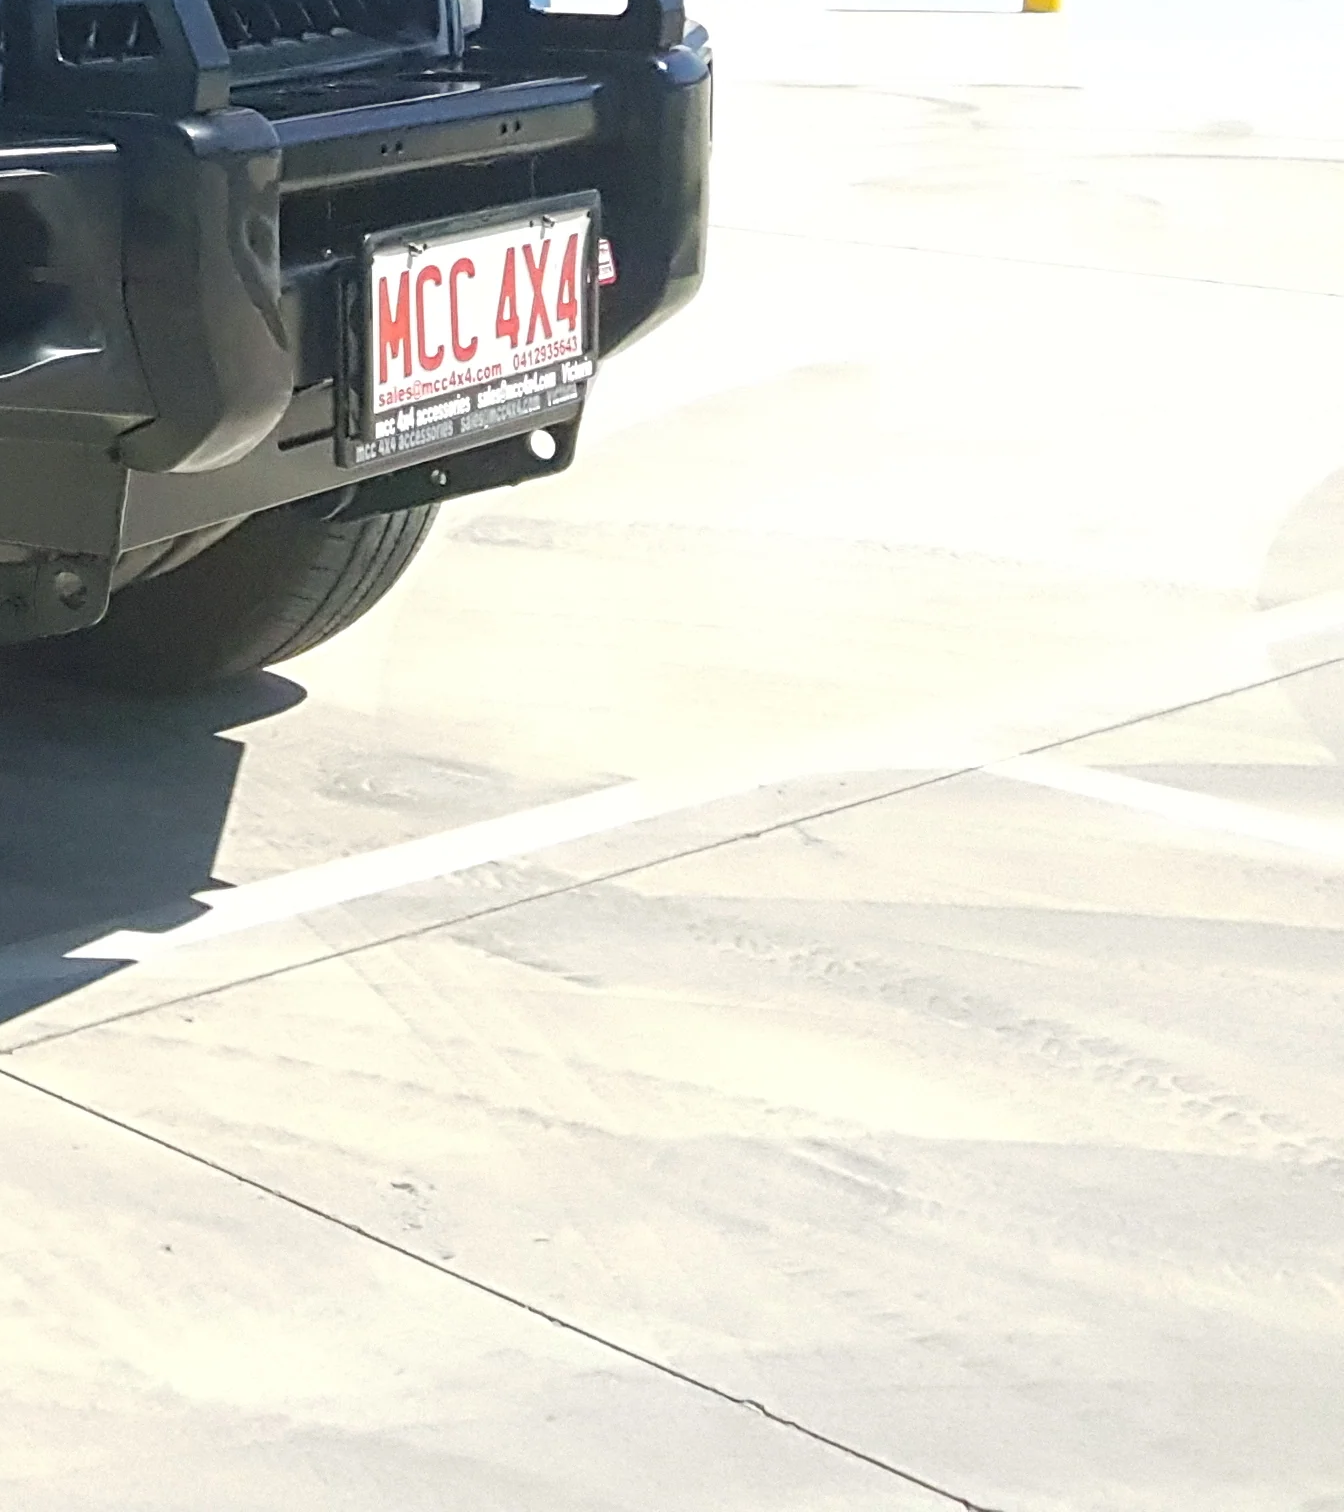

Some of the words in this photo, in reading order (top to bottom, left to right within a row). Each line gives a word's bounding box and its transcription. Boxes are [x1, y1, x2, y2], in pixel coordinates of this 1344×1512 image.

[378, 256, 479, 385] MCC
[495, 232, 579, 350] 4X4
[378, 363, 503, 408] sales@mcc4x4.com
[513, 335, 578, 371] 0412935643
